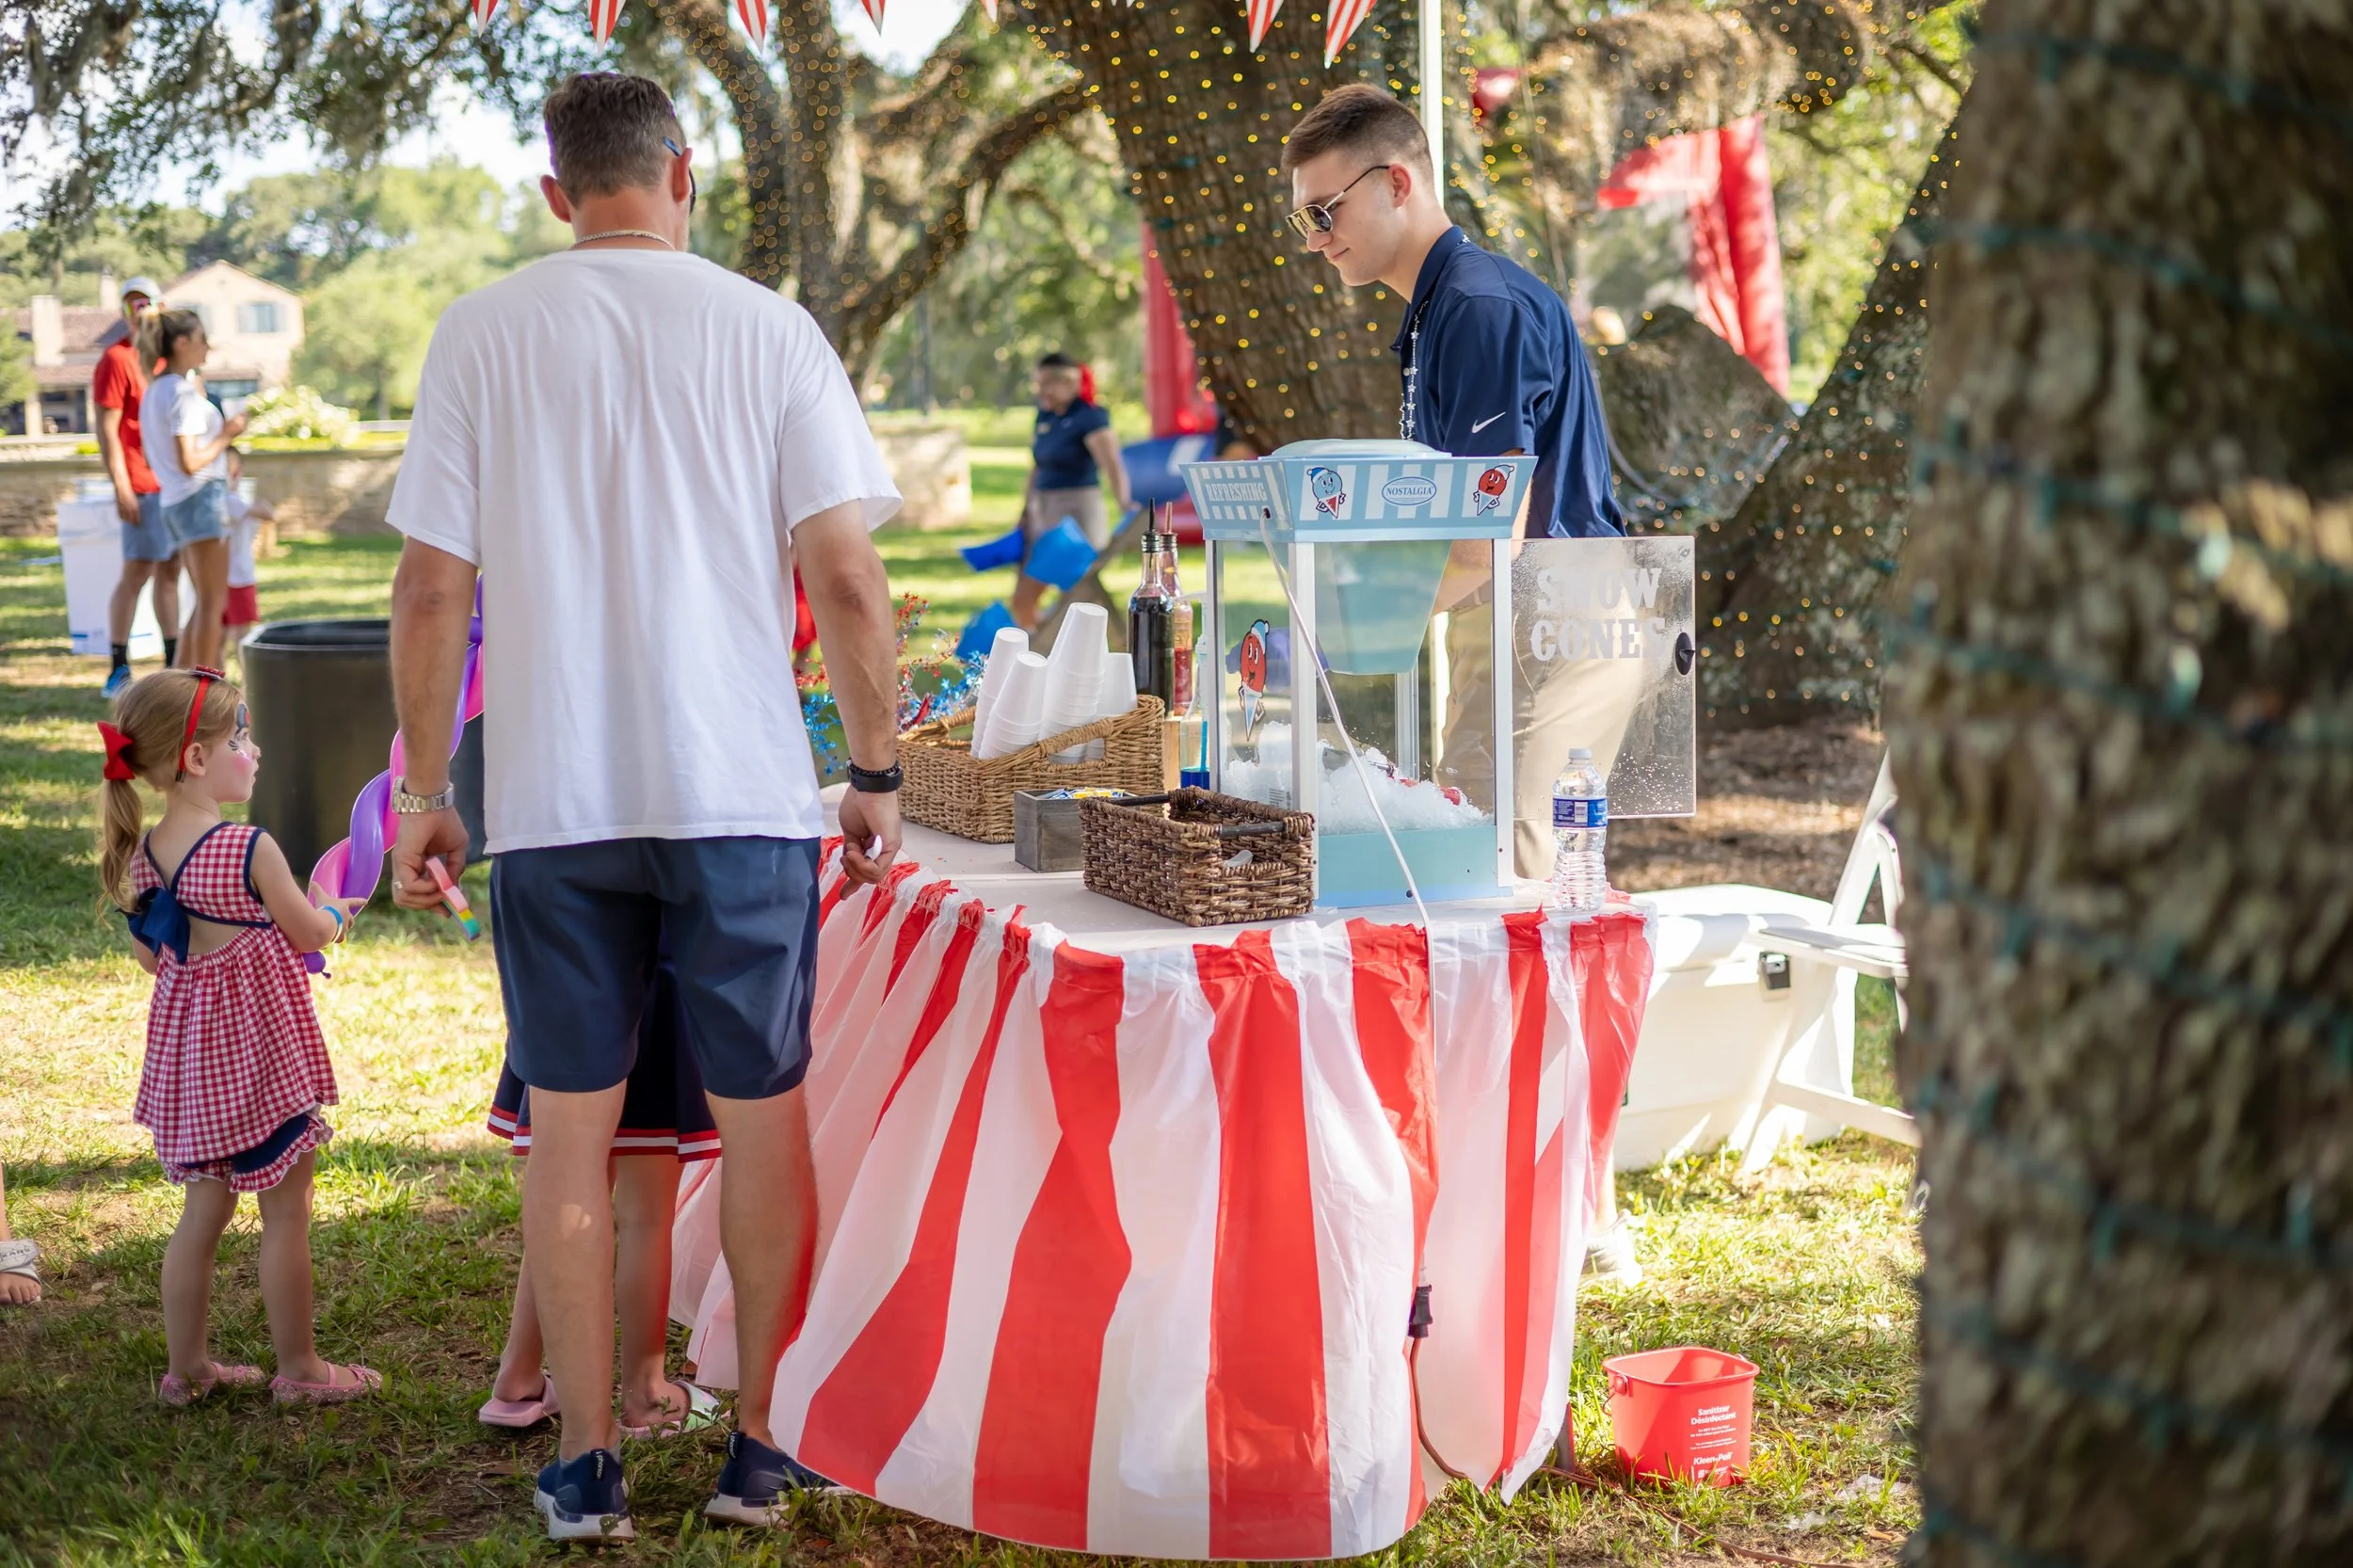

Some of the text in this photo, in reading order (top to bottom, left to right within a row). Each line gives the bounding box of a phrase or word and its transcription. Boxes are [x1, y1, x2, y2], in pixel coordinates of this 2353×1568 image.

[1205, 482, 1268, 502] REFRESHING
[1386, 487, 1433, 496] NOSTALGIA
[1536, 568, 1662, 612] SNOW
[1531, 616, 1666, 662] CONES
